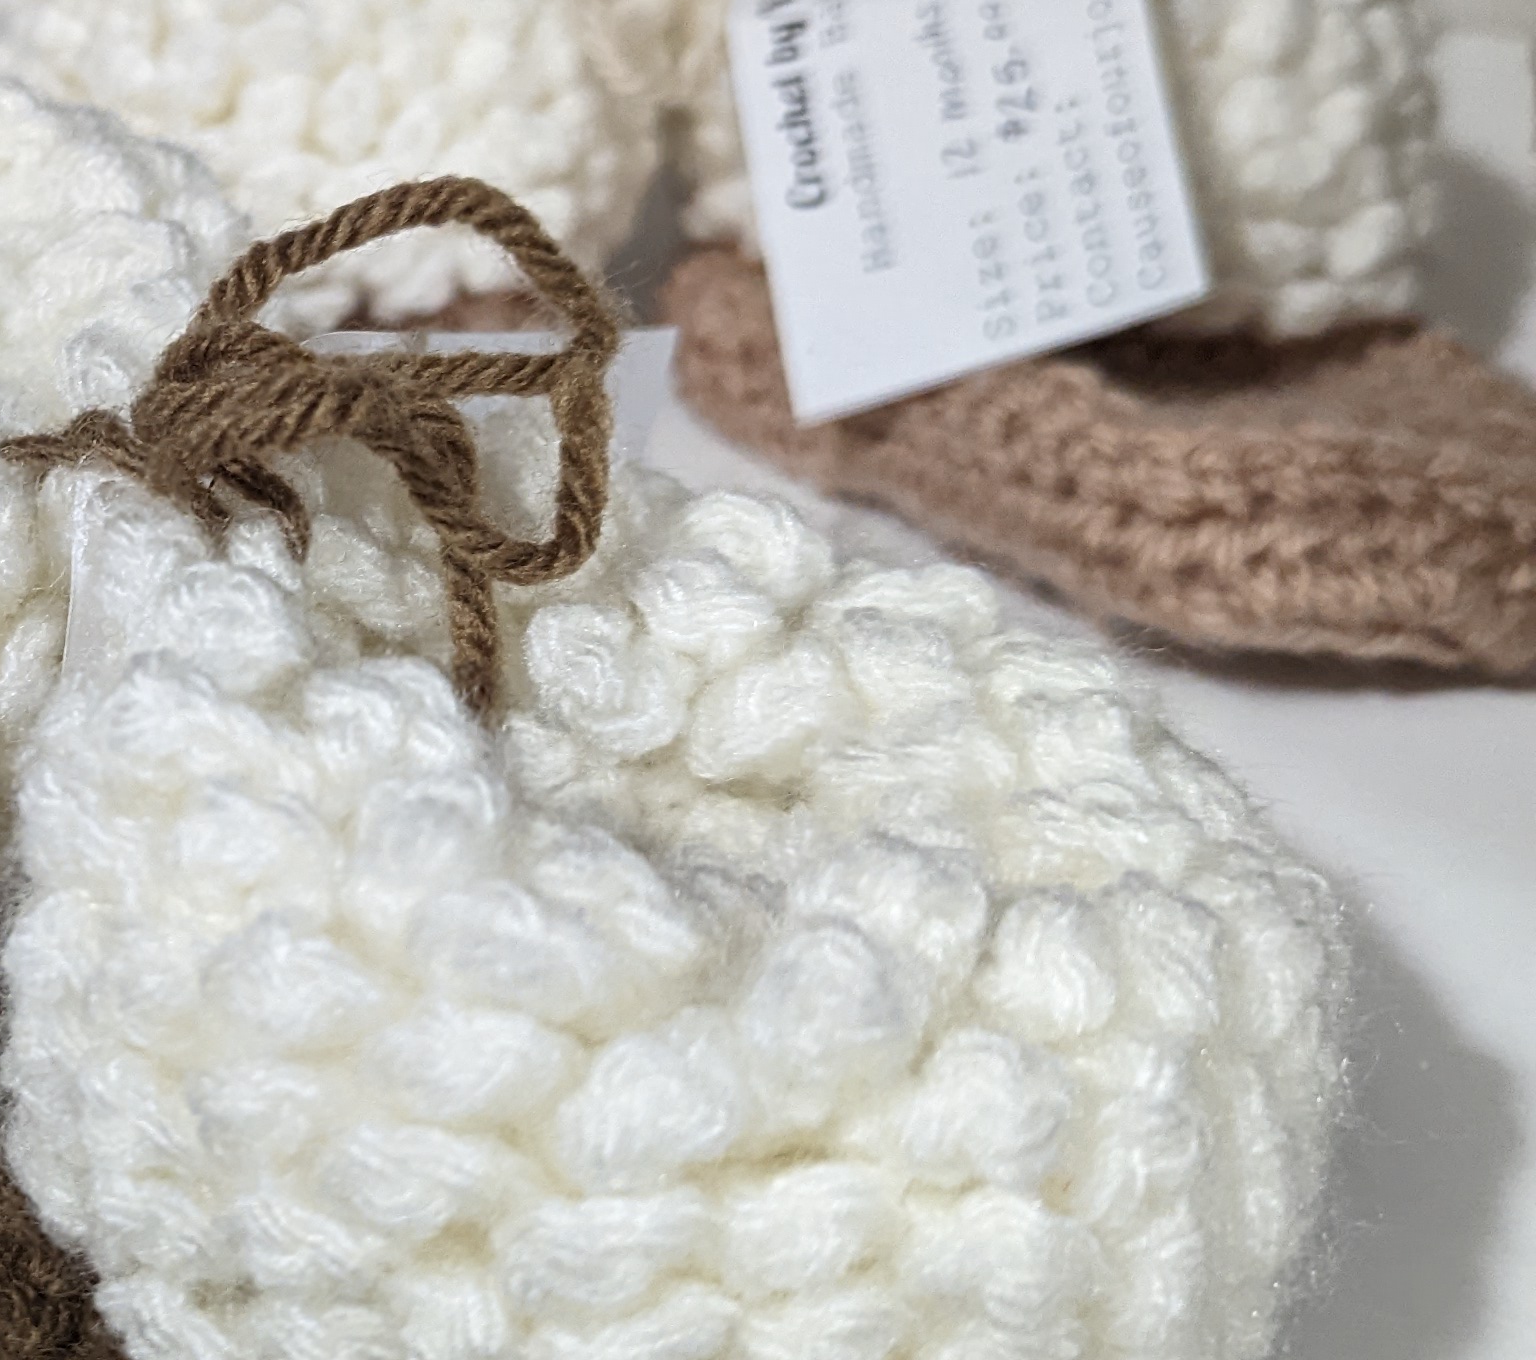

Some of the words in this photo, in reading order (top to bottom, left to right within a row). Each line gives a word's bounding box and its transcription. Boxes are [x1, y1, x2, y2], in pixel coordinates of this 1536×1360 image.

[765, 16, 807, 67] by
[917, 0, 965, 122] months
[773, 71, 828, 211] Crochet
[832, 68, 898, 275] Handmade
[942, 139, 985, 179] 12
[1055, 95, 1117, 309] Contact:
[969, 207, 1017, 340] Size:
[1014, 169, 1067, 325] Price:
